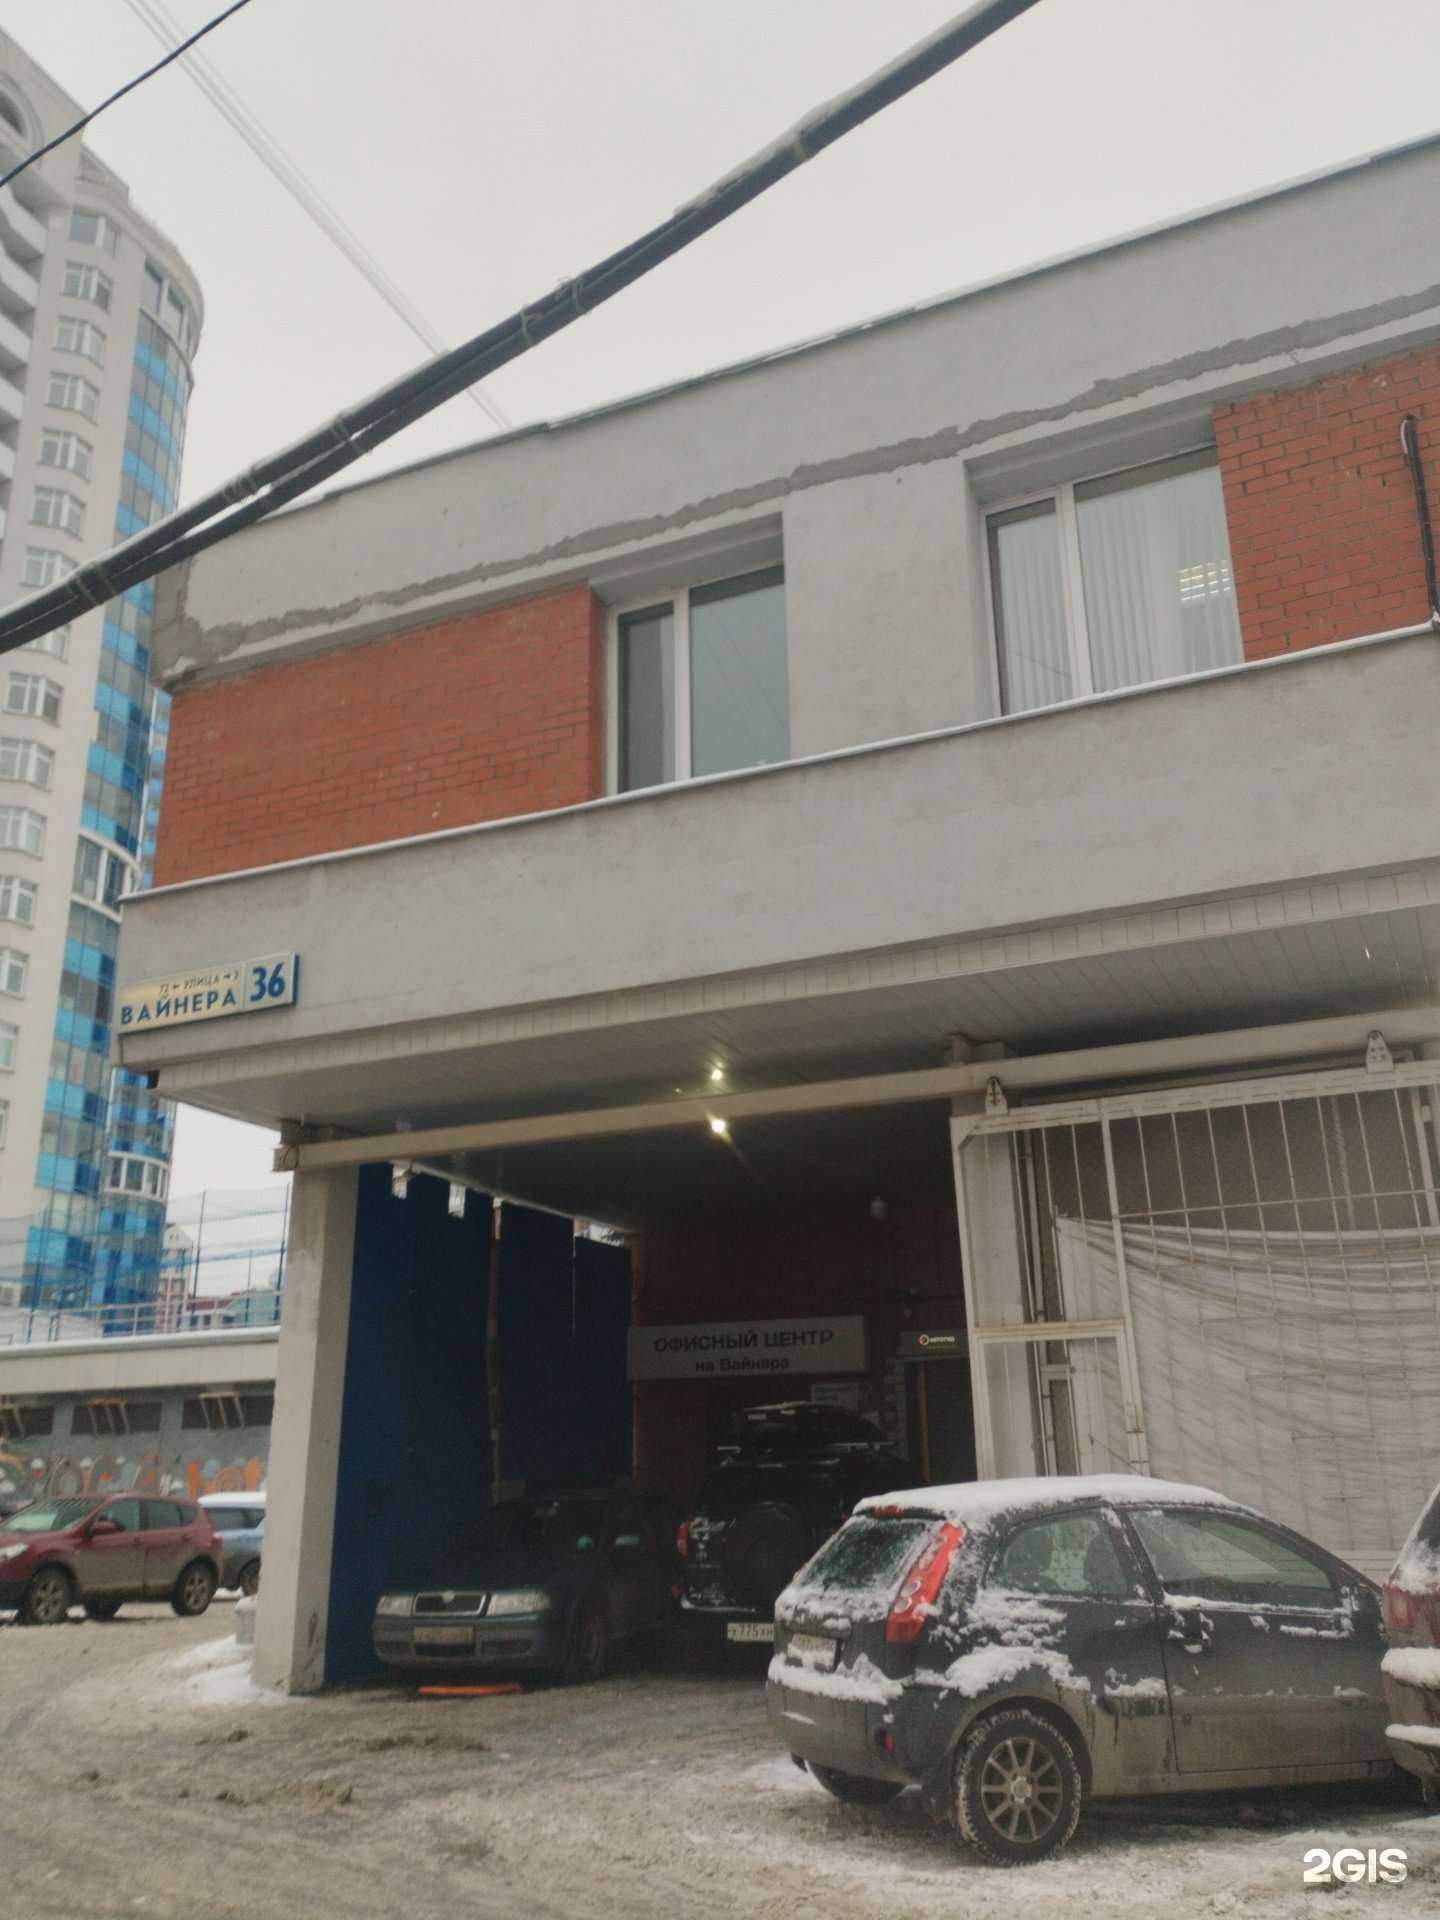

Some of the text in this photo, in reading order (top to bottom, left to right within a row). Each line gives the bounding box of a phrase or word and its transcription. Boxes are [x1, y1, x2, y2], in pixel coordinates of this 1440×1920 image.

[184, 973, 219, 989] УЛИЦА
[249, 962, 285, 1002] 36
[120, 989, 237, 1025] ВАЙНЕРА
[654, 1329, 834, 1353] ОФИСНЫЙ ЦЕНТР
[695, 1357, 790, 1372] на Вайнера
